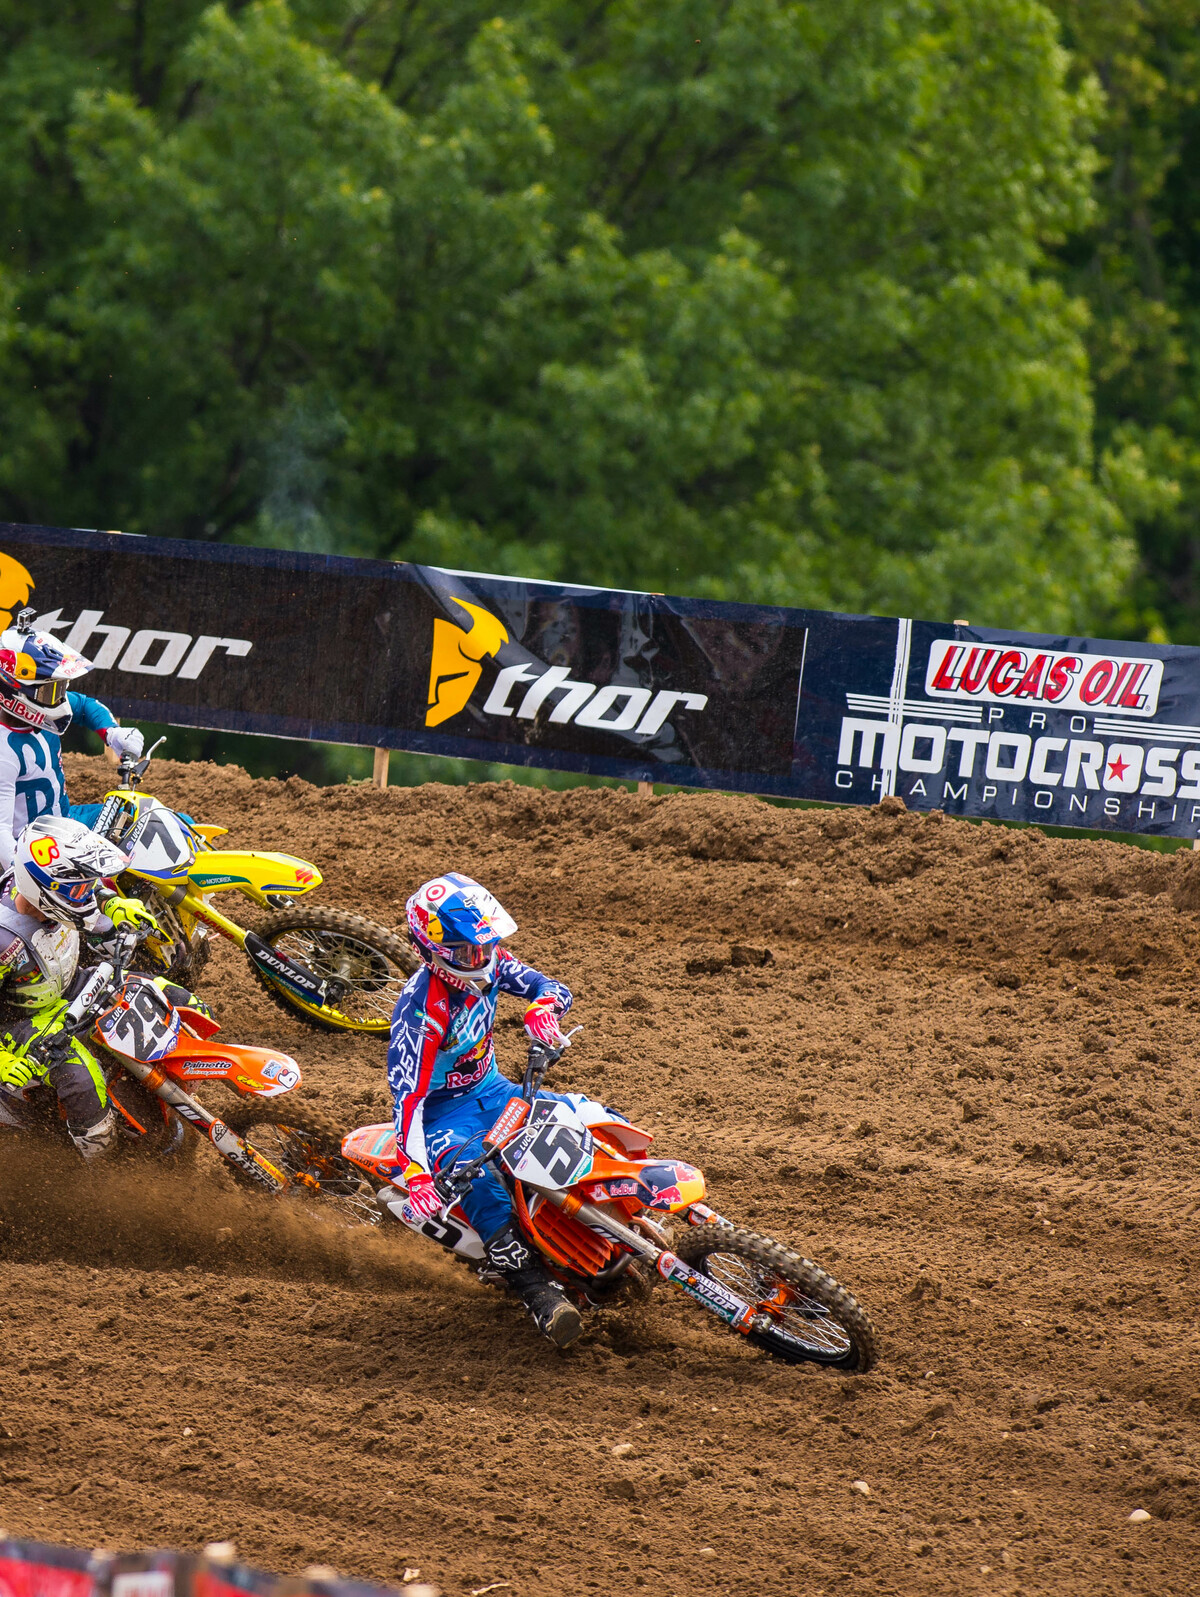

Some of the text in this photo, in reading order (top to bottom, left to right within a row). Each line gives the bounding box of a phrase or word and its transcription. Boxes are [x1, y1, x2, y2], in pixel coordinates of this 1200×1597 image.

[931, 644, 1153, 708] LUCAS OIL
[14, 704, 45, 725] Bull
[482, 662, 708, 735] thor
[988, 707, 1087, 734] PRO
[837, 716, 1200, 800] MOTOCROSS
[131, 820, 146, 842] LUCAS
[140, 812, 181, 864] 7
[206, 875, 233, 885] MOTOREX
[256, 949, 316, 991] DUNLOP
[124, 990, 135, 1003] OIL
[115, 992, 170, 1061] 29
[182, 1060, 233, 1070] Palmetto
[447, 1061, 487, 1089] Red
[489, 1101, 519, 1141] RENTHAL
[346, 1150, 375, 1168] DUNLOP
[529, 1114, 585, 1186] 5
[674, 1269, 738, 1311] DNLOP
[683, 1286, 732, 1323] MOTOREX
